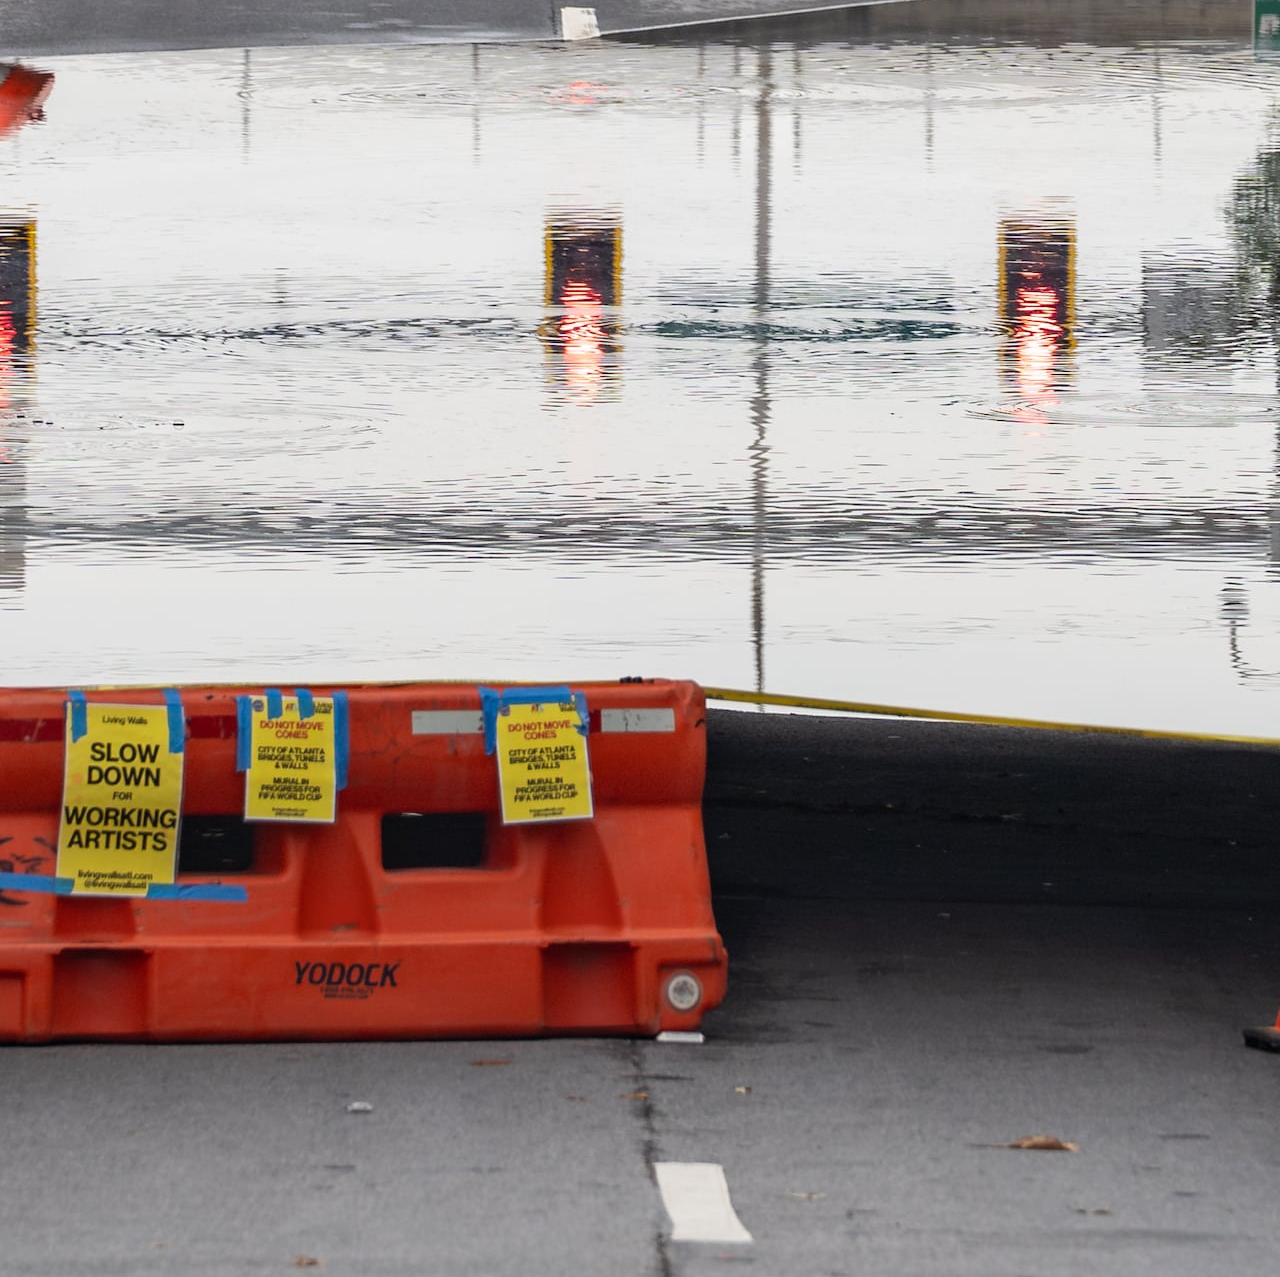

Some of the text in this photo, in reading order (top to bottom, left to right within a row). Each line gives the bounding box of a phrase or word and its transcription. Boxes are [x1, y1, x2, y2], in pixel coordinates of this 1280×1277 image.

[102, 715, 148, 725] Living Walls
[260, 720, 324, 730] DO NOT MOVE
[508, 720, 571, 732] DO NOT MOVE
[275, 730, 308, 739] CONES
[524, 731, 557, 740] CONES
[90, 742, 160, 763] SLOW
[258, 746, 324, 755] CITY OF ATLANTA
[509, 749, 527, 757] CITY
[539, 745, 575, 754] ATLANTA
[282, 762, 308, 770] WALLS
[534, 761, 560, 770] WALLS
[87, 766, 160, 787] DOWN
[527, 778, 554, 786] MURAL
[516, 786, 558, 794] PROGRESS
[112, 792, 132, 800] FOR
[258, 792, 276, 800] FIFA
[533, 793, 562, 801] WORLD
[64, 806, 176, 828] WORKING
[67, 830, 167, 851] ARTISTS
[295, 961, 399, 988] YODOCK
